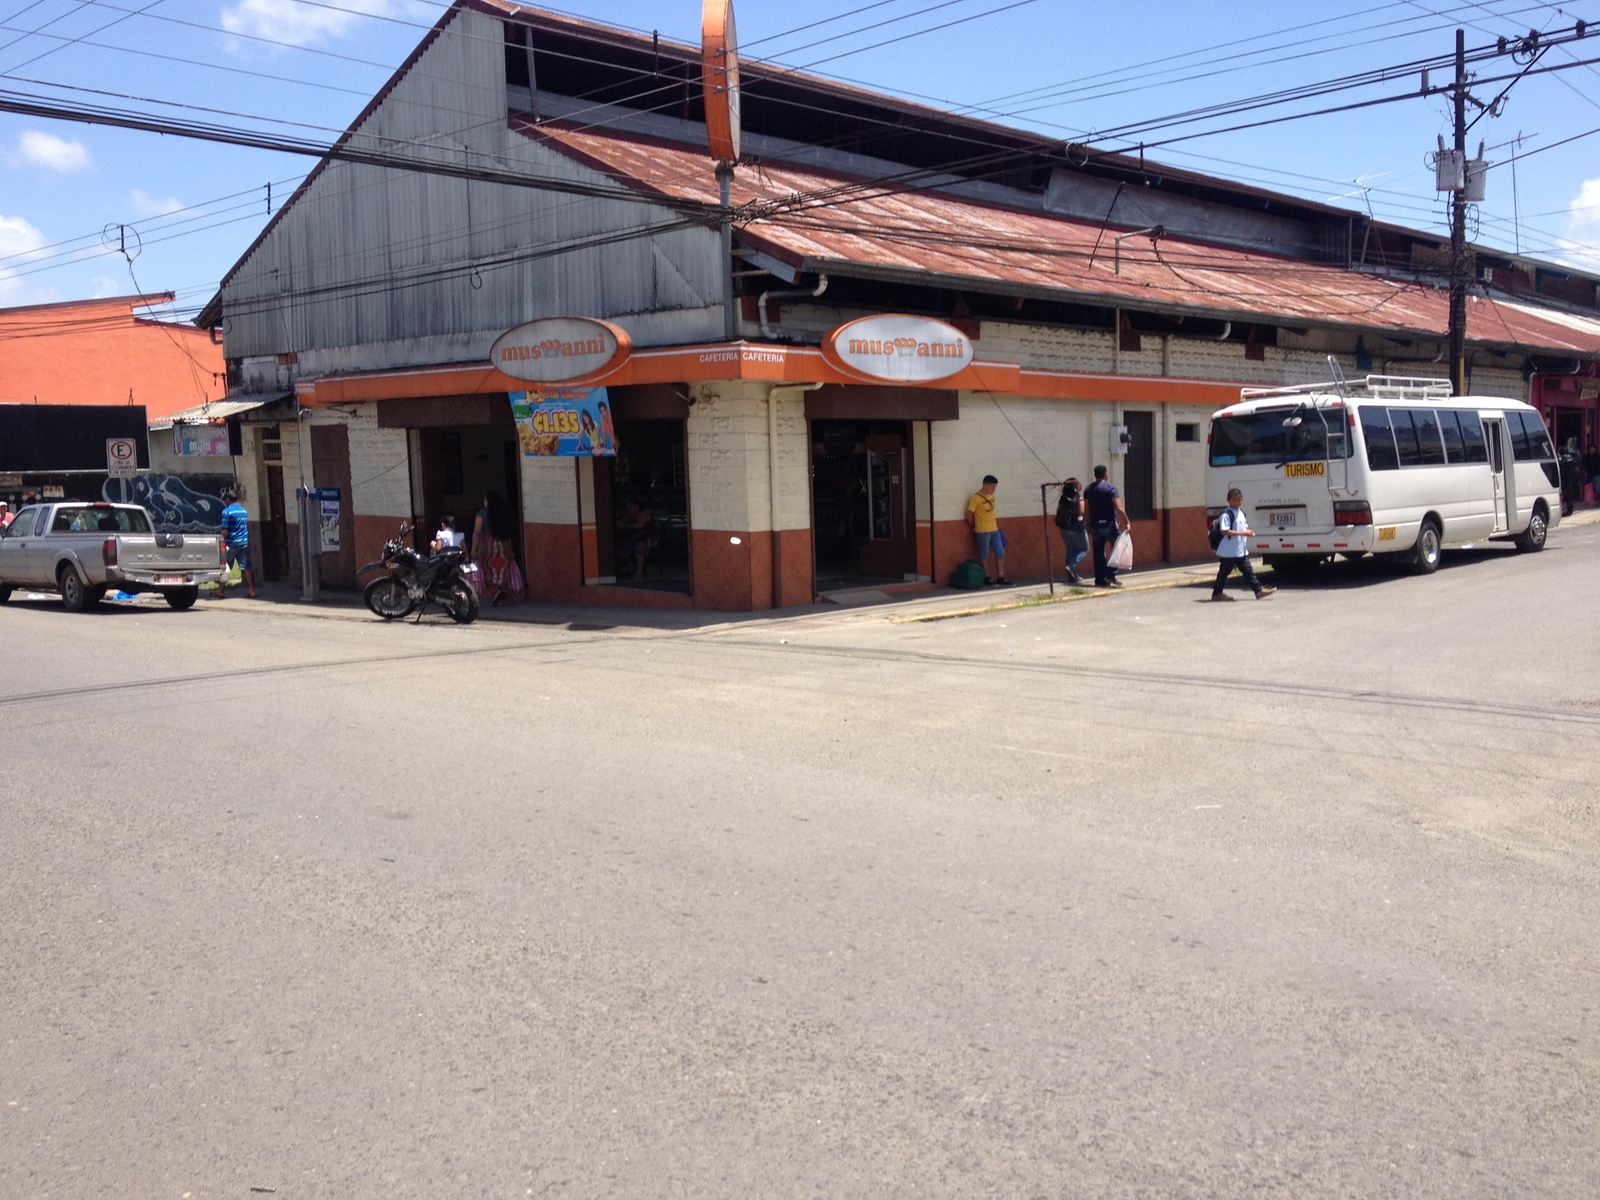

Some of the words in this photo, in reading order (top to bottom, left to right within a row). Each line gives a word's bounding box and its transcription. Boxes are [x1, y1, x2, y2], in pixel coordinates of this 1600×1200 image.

[699, 352, 738, 363] CAFETERIA
[742, 351, 784, 363] CAFETERIA
[116, 444, 126, 457] E
[1285, 462, 1324, 477] TURISMO
